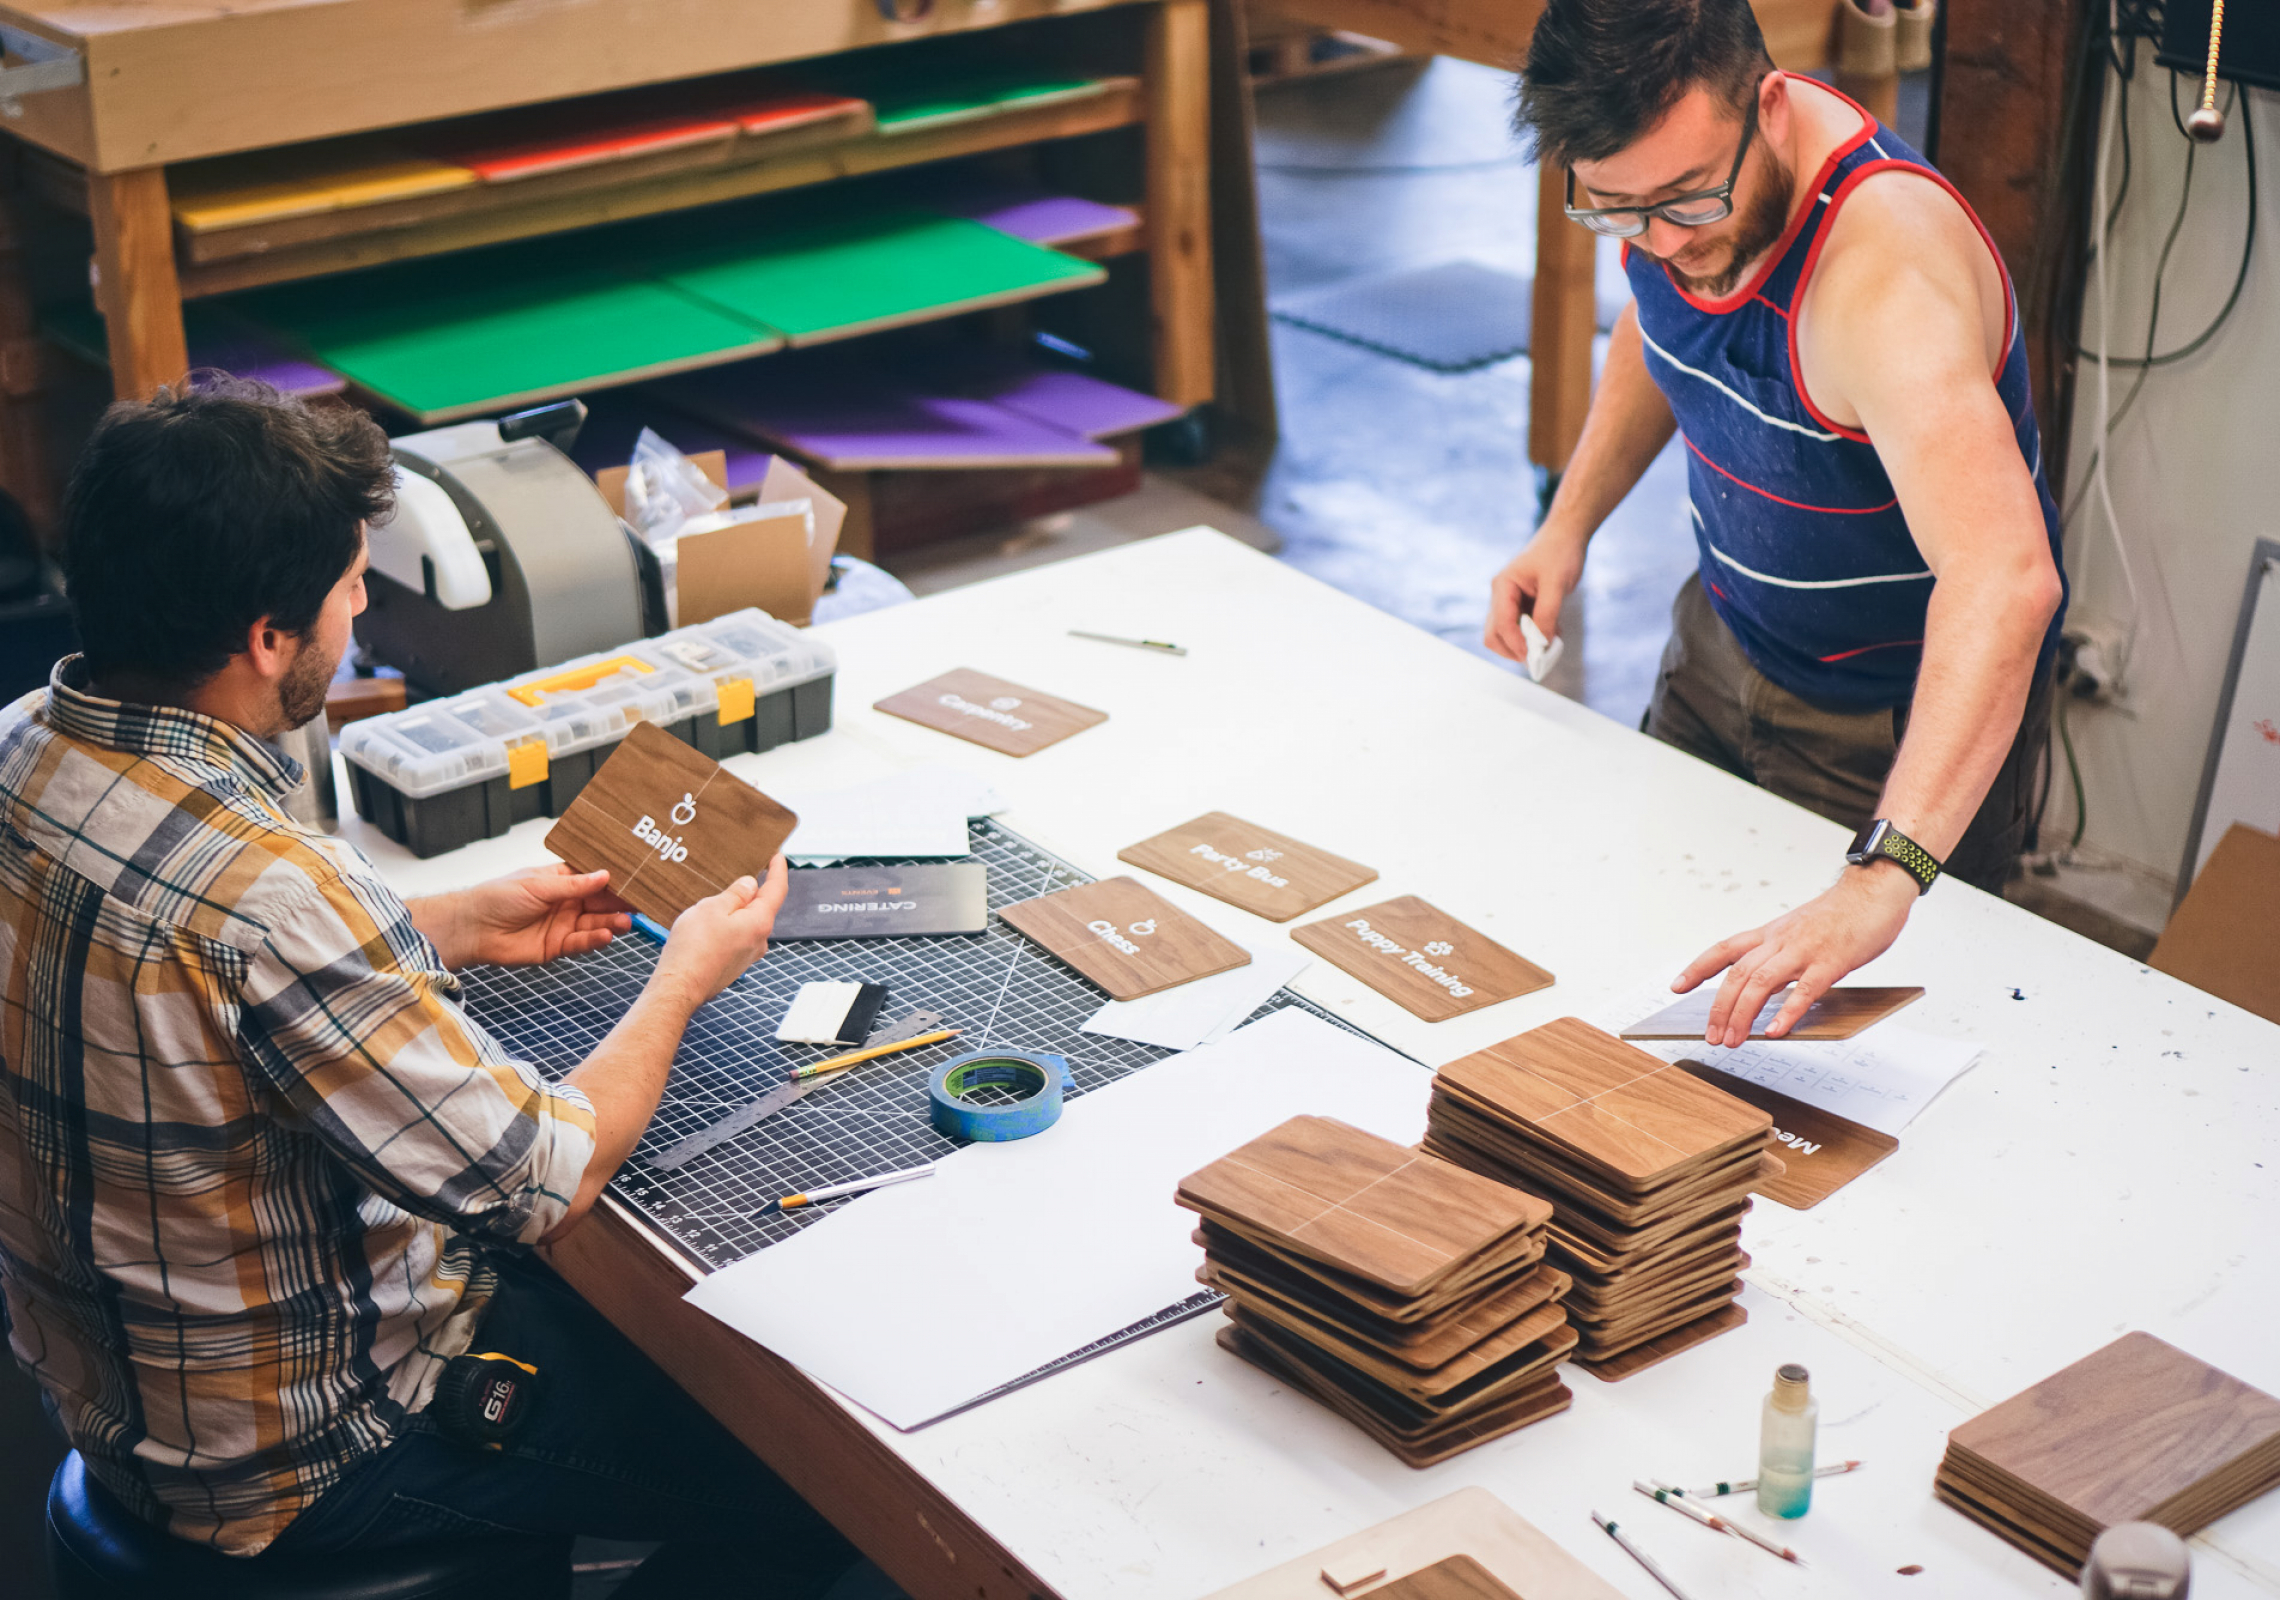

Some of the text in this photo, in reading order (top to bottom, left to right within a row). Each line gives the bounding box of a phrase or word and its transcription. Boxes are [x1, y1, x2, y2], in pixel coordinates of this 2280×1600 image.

[939, 694, 1032, 731] Carpentry
[632, 814, 688, 862] Banjo
[1190, 844, 1289, 888] Party Bus
[818, 901, 917, 913] CATERING
[1087, 920, 1140, 955] Chess
[1345, 919, 1474, 997] Puppy Training
[618, 1174, 631, 1182] 16
[635, 1187, 649, 1196] 15
[652, 1201, 666, 1210] 14
[669, 1215, 683, 1224] 13
[686, 1229, 701, 1238] 12
[704, 1243, 719, 1252] 11
